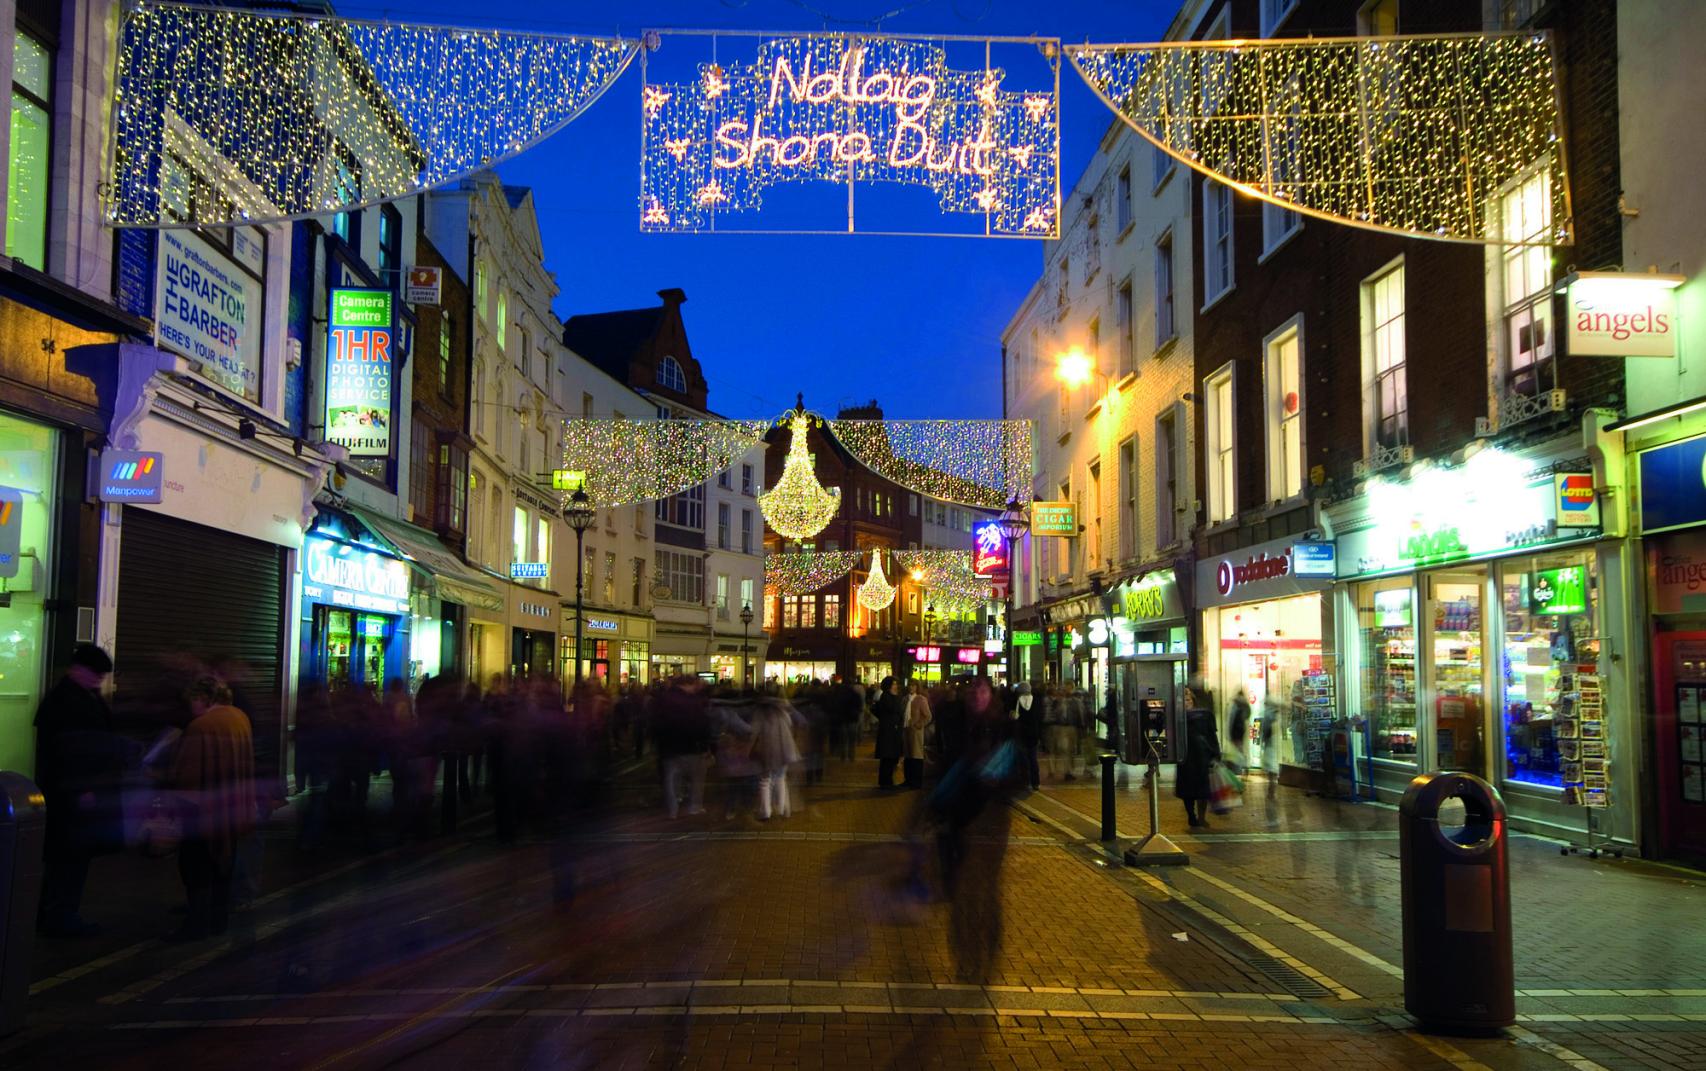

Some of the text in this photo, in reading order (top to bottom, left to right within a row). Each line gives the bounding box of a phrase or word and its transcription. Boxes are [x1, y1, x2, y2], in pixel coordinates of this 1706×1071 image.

[768, 46, 935, 121] Nollaig
[714, 114, 997, 175] Shona Duit
[165, 254, 179, 314] THE
[180, 264, 245, 324] GRAFTON
[339, 295, 385, 307] Camera
[180, 297, 237, 350] BARBER
[342, 310, 381, 321] Centre
[1577, 305, 1669, 340] angels
[194, 343, 216, 361] YOUR
[332, 329, 391, 362] 1HR
[332, 364, 389, 375] DIGITAL
[332, 376, 388, 387] PHOTO
[331, 389, 388, 400] SERVICE
[106, 487, 155, 496] Manpower
[1561, 488, 1593, 496] LOTTO
[1036, 515, 1073, 523] CIGAR
[1233, 551, 1291, 584] vodafone
[1088, 618, 1108, 644] 3
